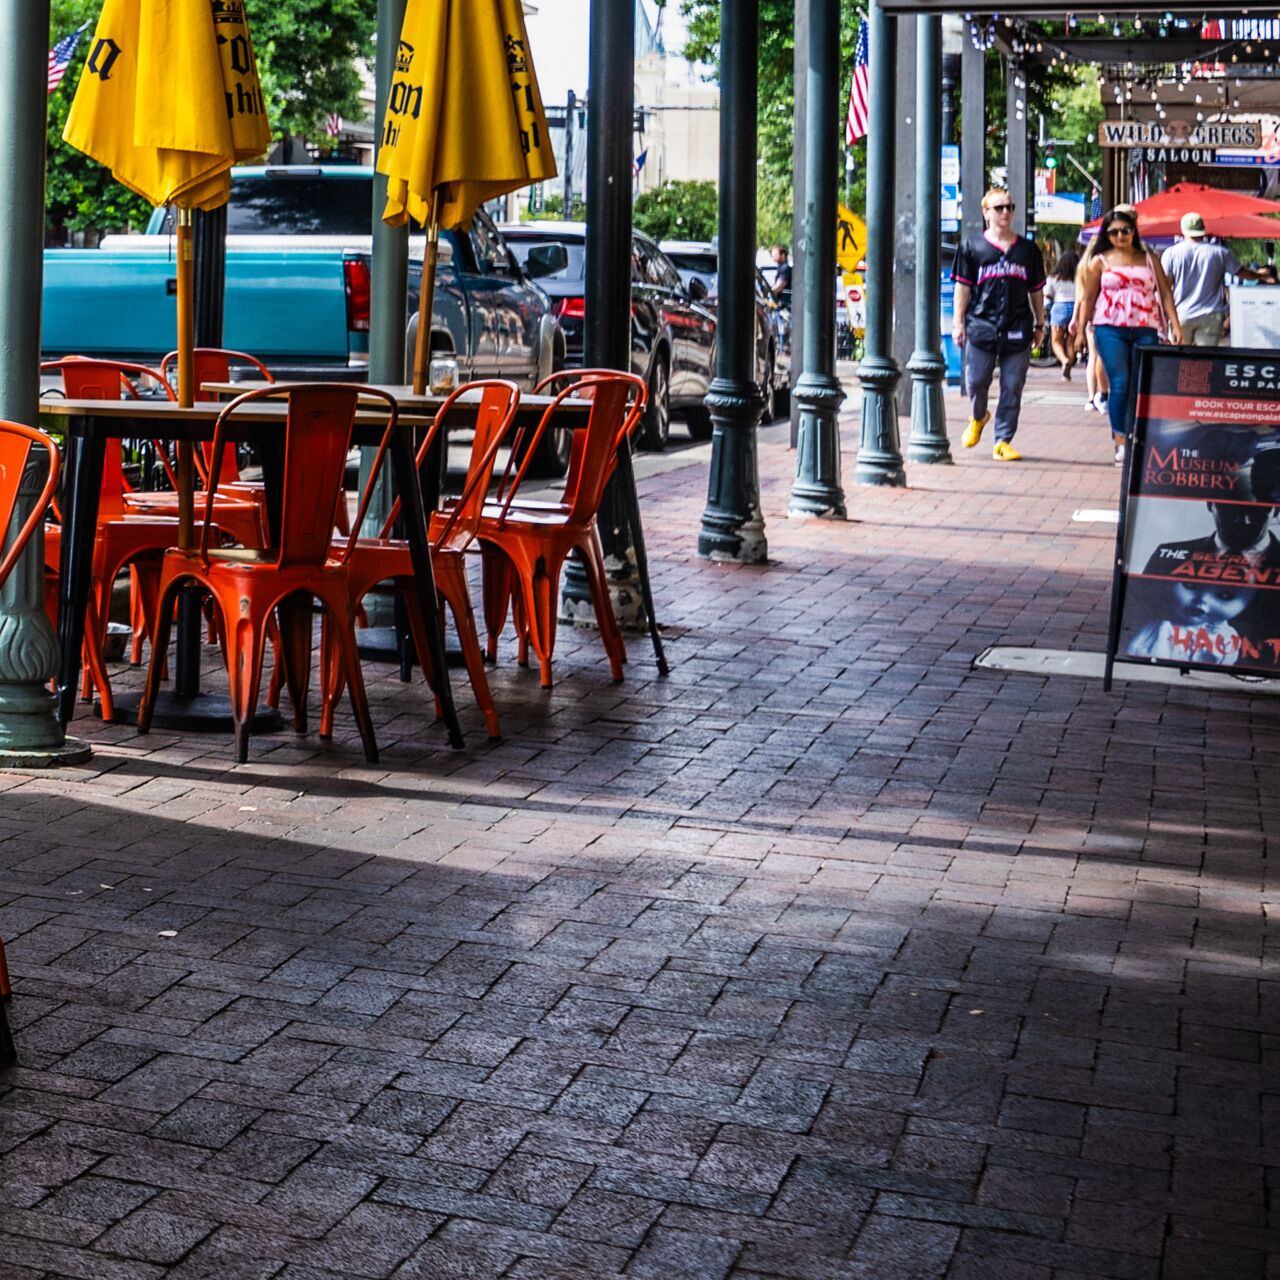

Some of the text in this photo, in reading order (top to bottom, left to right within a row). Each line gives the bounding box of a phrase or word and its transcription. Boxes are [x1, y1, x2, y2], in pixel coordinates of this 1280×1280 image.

[1105, 122, 1163, 144] WILD
[1146, 149, 1212, 163] SALOON
[1229, 379, 1249, 388] ON
[1194, 400, 1224, 409] BOOK
[1226, 402, 1254, 410] YOUR
[1147, 445, 1241, 473] MUSEUM
[1181, 448, 1200, 458] THE
[1144, 469, 1239, 490] ROBBERY
[1159, 548, 1189, 560] THE
